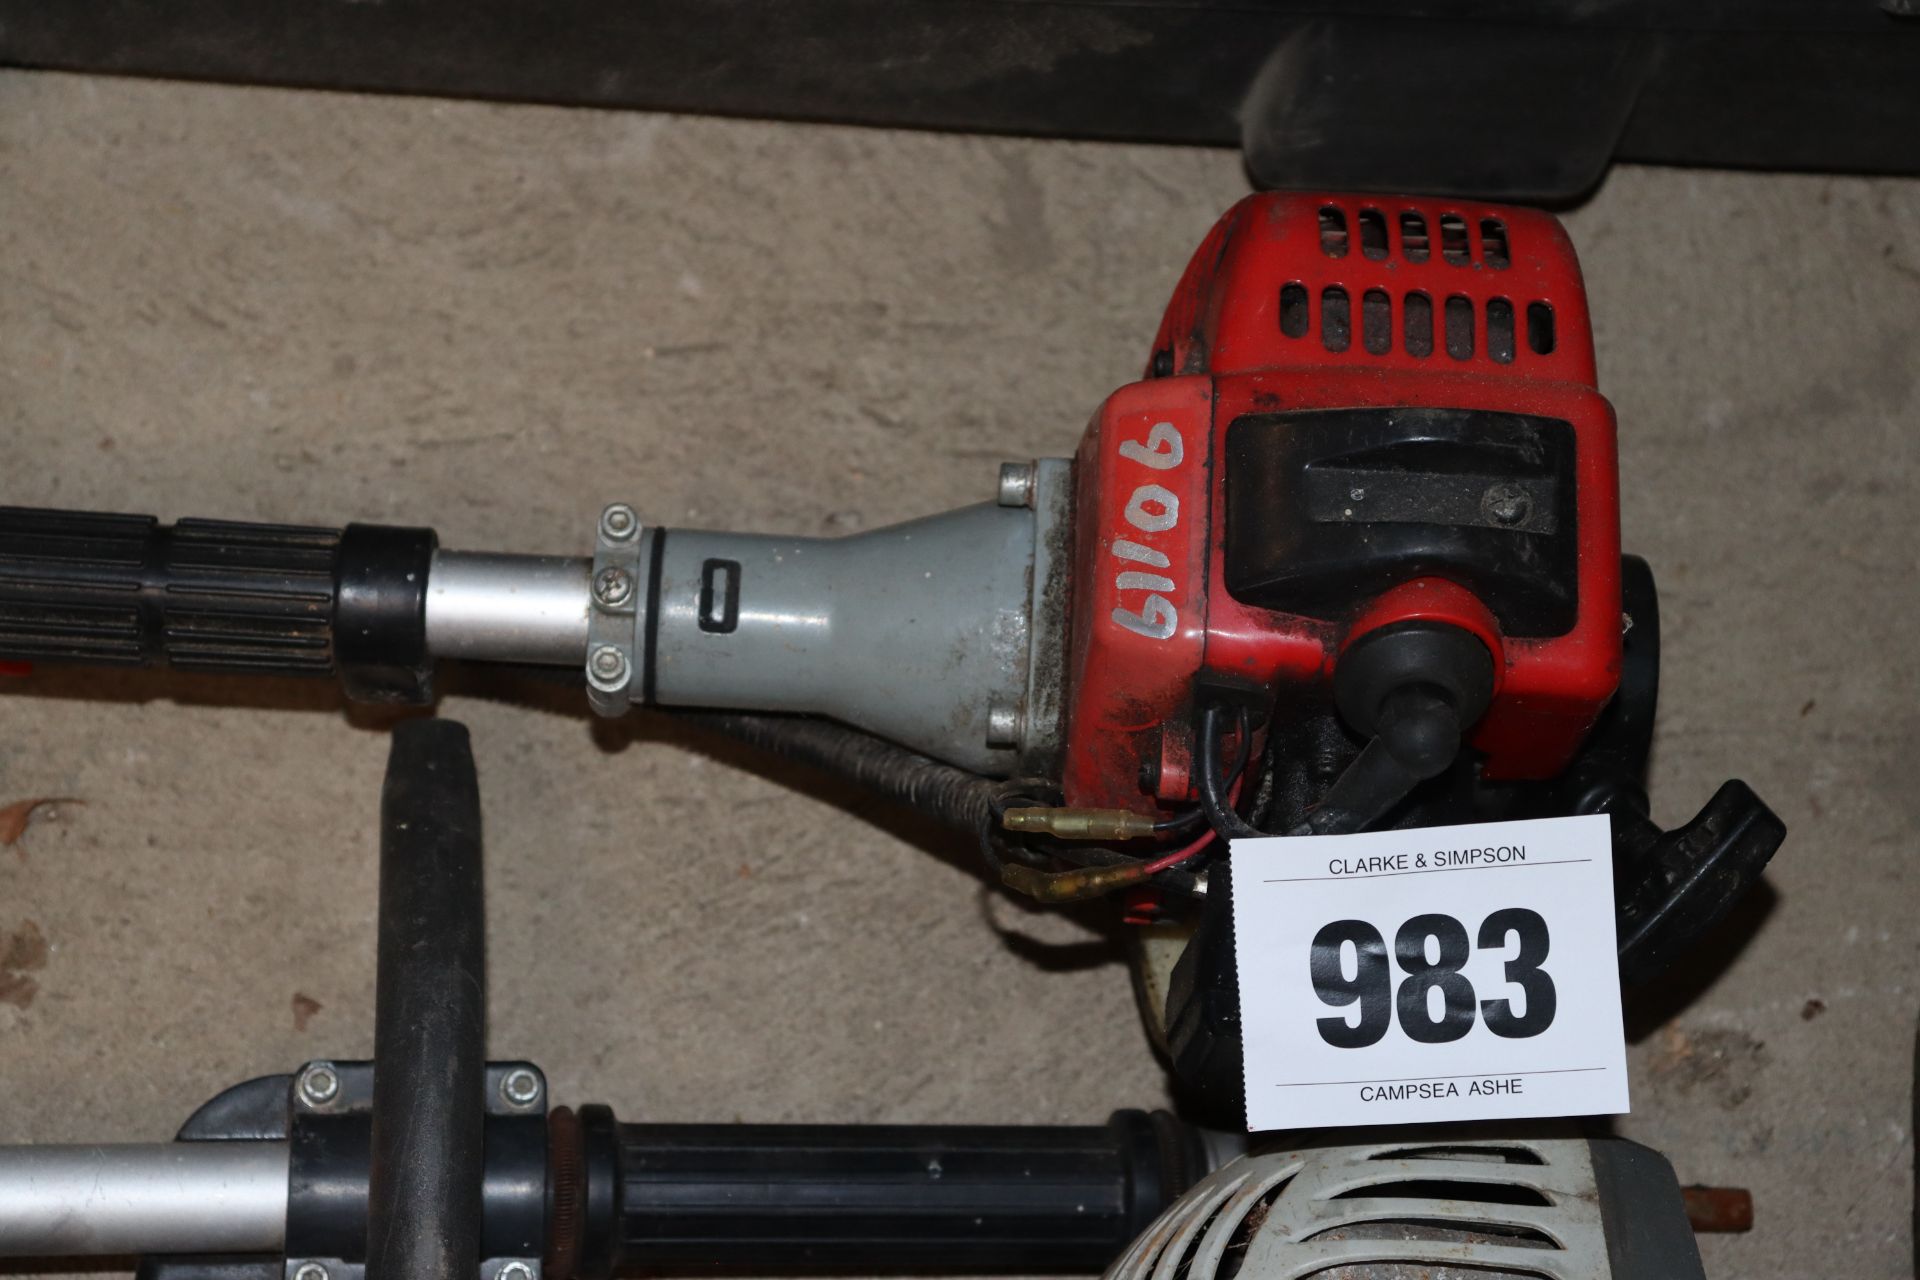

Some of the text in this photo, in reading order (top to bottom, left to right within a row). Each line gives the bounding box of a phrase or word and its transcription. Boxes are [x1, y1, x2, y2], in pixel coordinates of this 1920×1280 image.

[1328, 845, 1527, 875] CLARKE & SIMPSON
[1309, 907, 1557, 1049] 983
[1360, 1078, 1524, 1102] CAMPSEA ASHE
